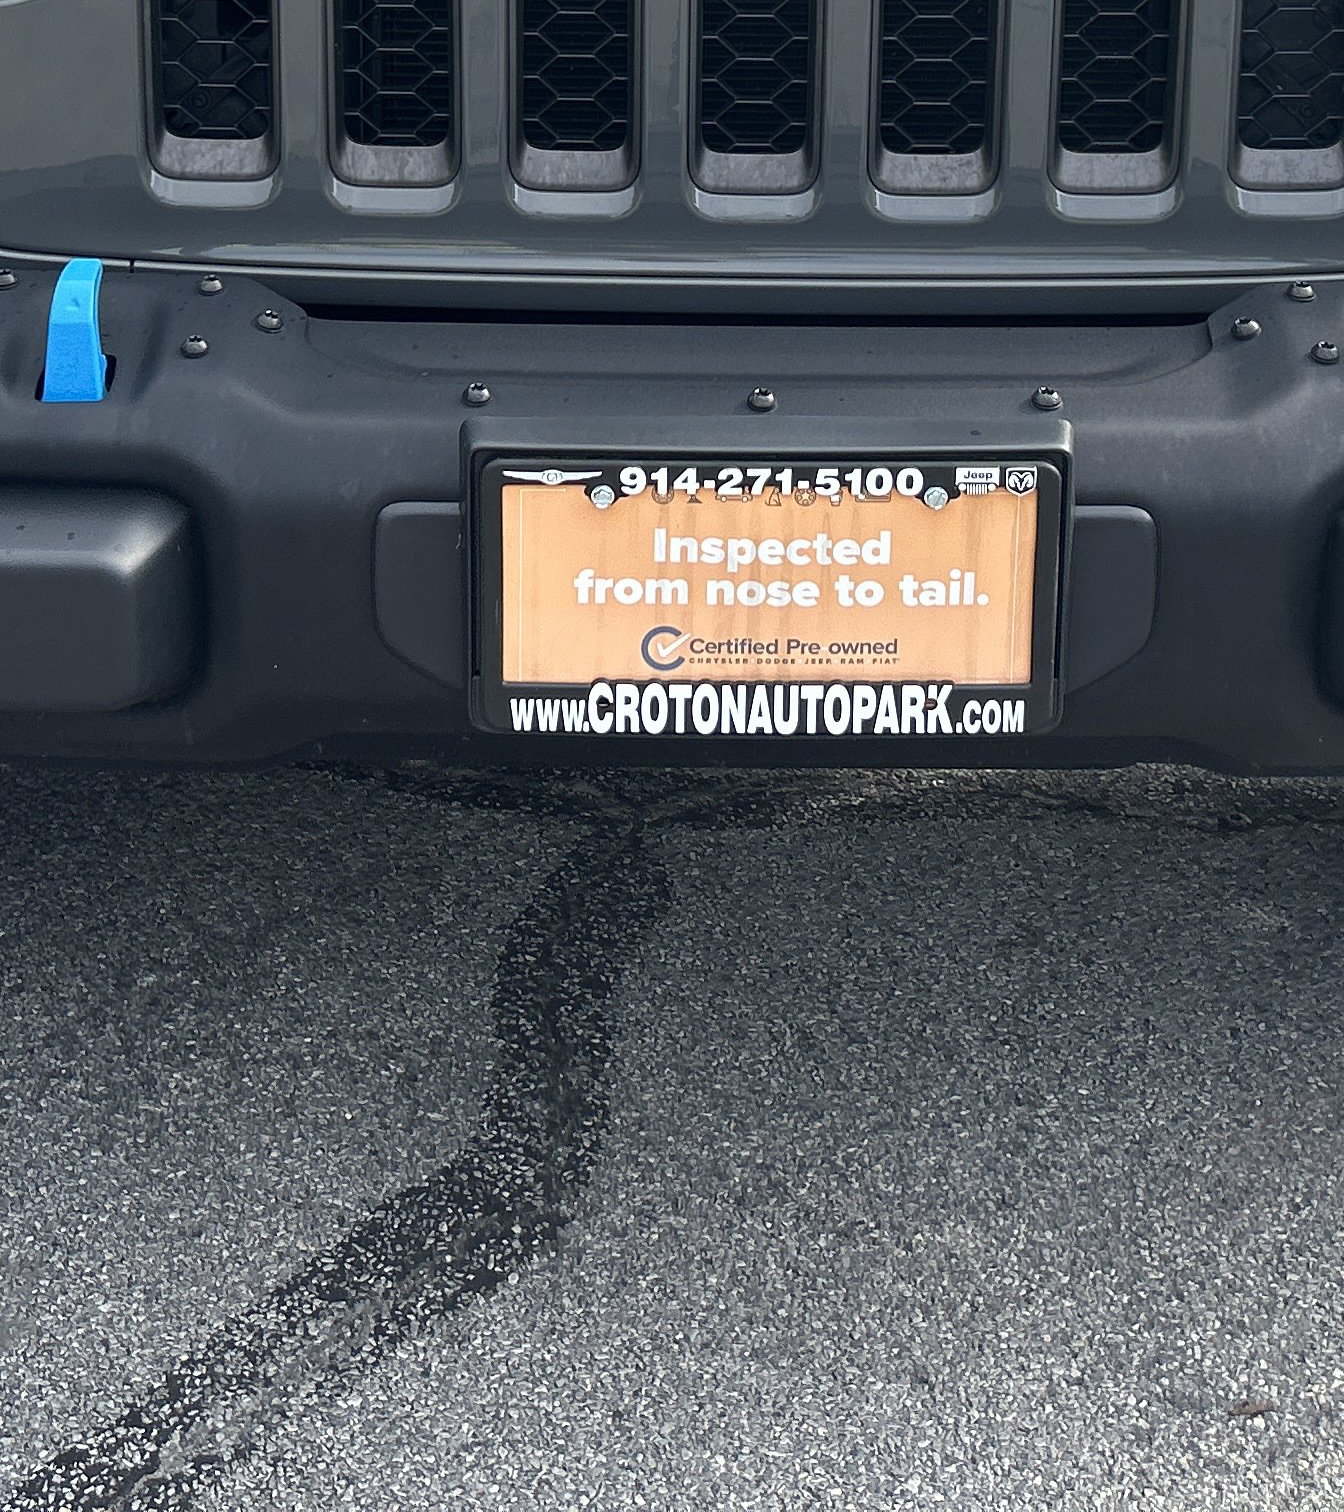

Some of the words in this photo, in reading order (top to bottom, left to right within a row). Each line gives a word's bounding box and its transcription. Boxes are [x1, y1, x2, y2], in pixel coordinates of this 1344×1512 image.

[619, 466, 924, 496] 914-271-5100
[963, 470, 993, 481] Jeep
[653, 528, 892, 571] Inspected
[573, 569, 689, 606] from
[705, 572, 820, 608] nose
[834, 573, 885, 607] to
[898, 571, 990, 607] tail.
[689, 637, 779, 656] Certified
